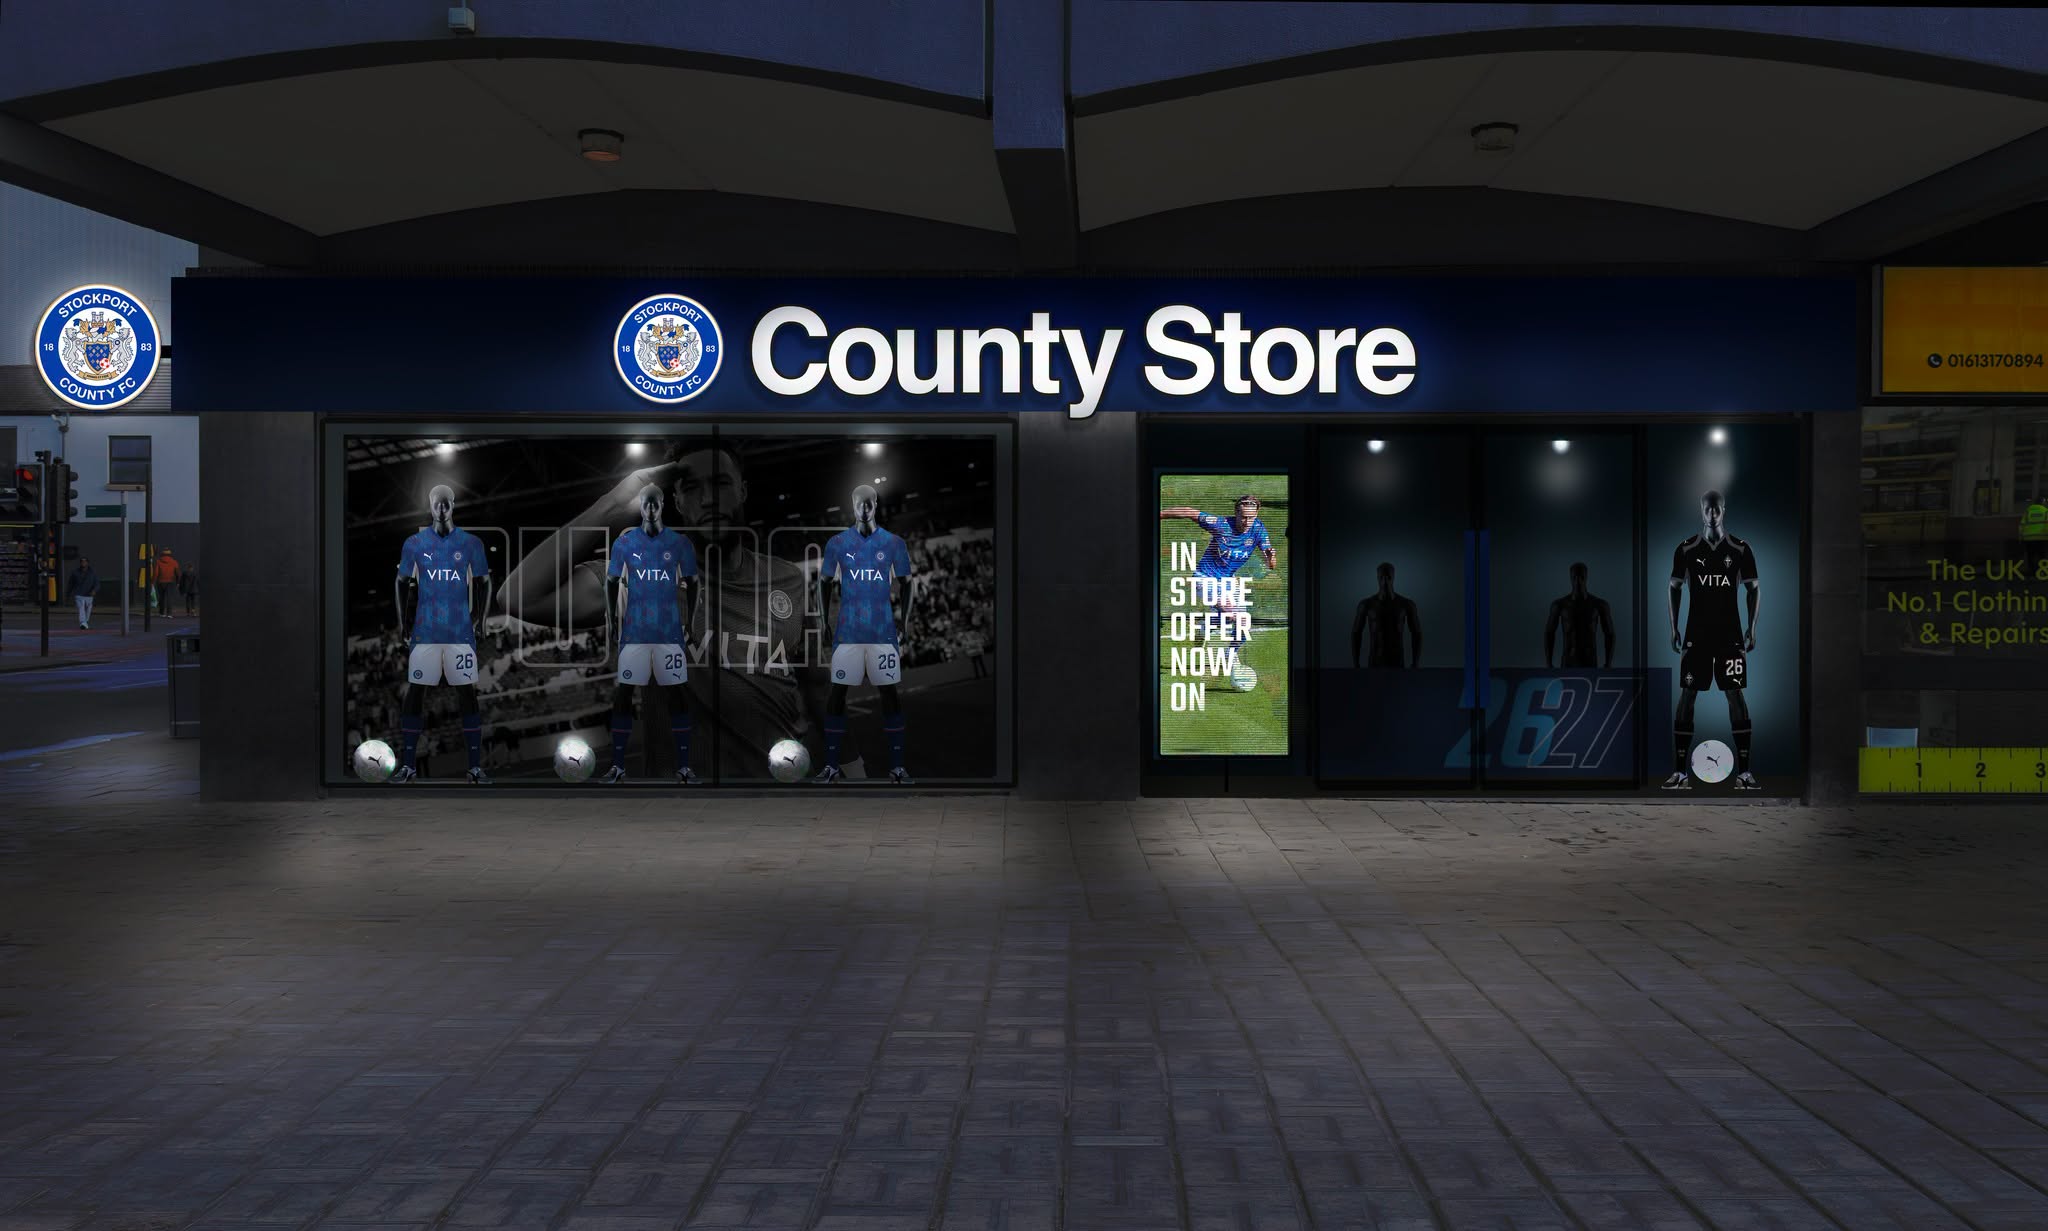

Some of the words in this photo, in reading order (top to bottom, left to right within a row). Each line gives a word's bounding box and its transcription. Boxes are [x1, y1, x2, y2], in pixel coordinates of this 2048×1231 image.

[58, 293, 138, 319] STOCKPORT
[634, 302, 703, 324] STOCKPORT
[44, 343, 54, 351] 18
[140, 343, 152, 351] 83
[705, 345, 716, 353] 83
[751, 305, 1124, 419] County
[1144, 304, 1417, 397] Store
[1948, 354, 2044, 368] 01613170894
[59, 377, 116, 401] COUNTY
[118, 377, 136, 394] FC
[635, 375, 684, 396] COUNTY
[686, 375, 702, 390] FC
[1171, 542, 1197, 571] IN
[427, 569, 461, 581] VITA
[636, 569, 670, 581] VITA
[850, 569, 884, 581] VITA
[1698, 574, 1731, 586] VITA
[1927, 558, 1976, 581] The
[1986, 559, 2025, 581] UK
[1170, 577, 1253, 606] STORE
[1888, 591, 1942, 613] No.1
[1170, 612, 1252, 641] OFFER
[1920, 622, 1941, 644] &
[1951, 621, 2048, 650] Repairs
[456, 654, 473, 670] 26
[665, 654, 682, 670] 26
[687, 629, 790, 677] VITA
[879, 654, 896, 670] 26
[1171, 647, 1235, 677] NOW
[1725, 658, 1743, 676] 26
[1170, 682, 1206, 712] ON
[1915, 763, 1922, 778] 1
[1975, 763, 1986, 778] 2
[2035, 763, 2046, 778] 3
